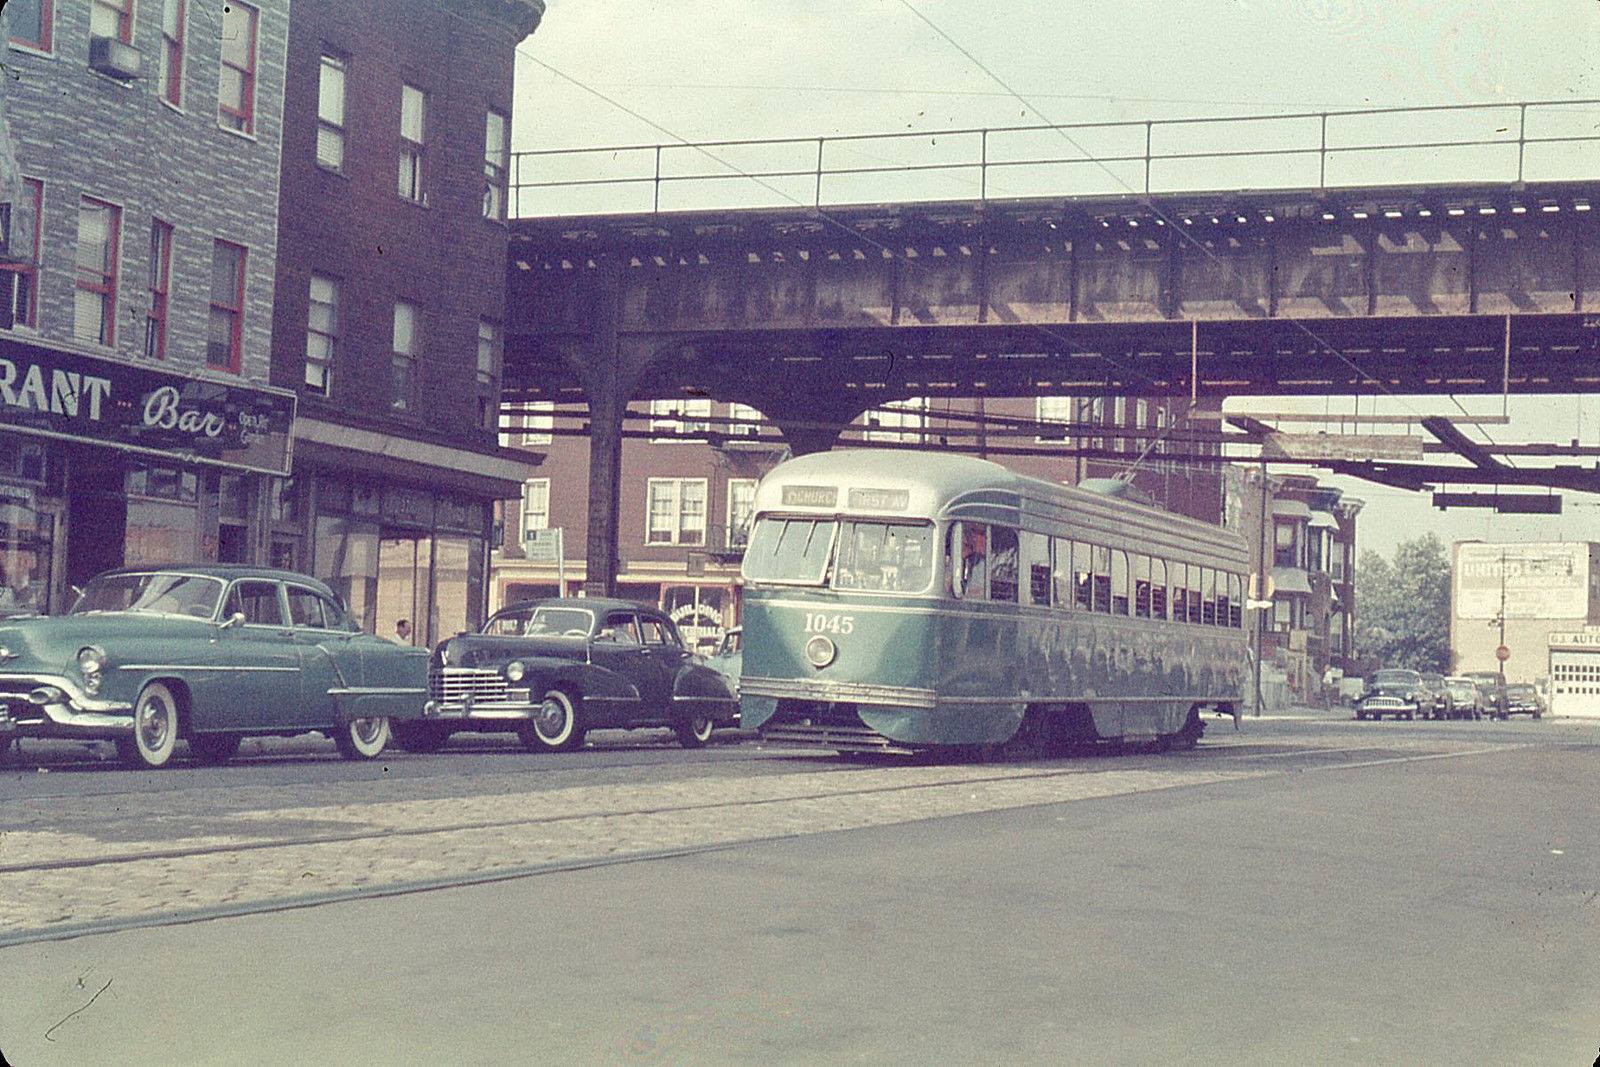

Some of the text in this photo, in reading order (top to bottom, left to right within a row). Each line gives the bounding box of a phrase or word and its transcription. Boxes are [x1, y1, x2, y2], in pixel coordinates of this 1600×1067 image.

[0, 359, 225, 437] RANT Bar
[1463, 562, 1522, 578] UNITED
[804, 613, 855, 635] 1045
